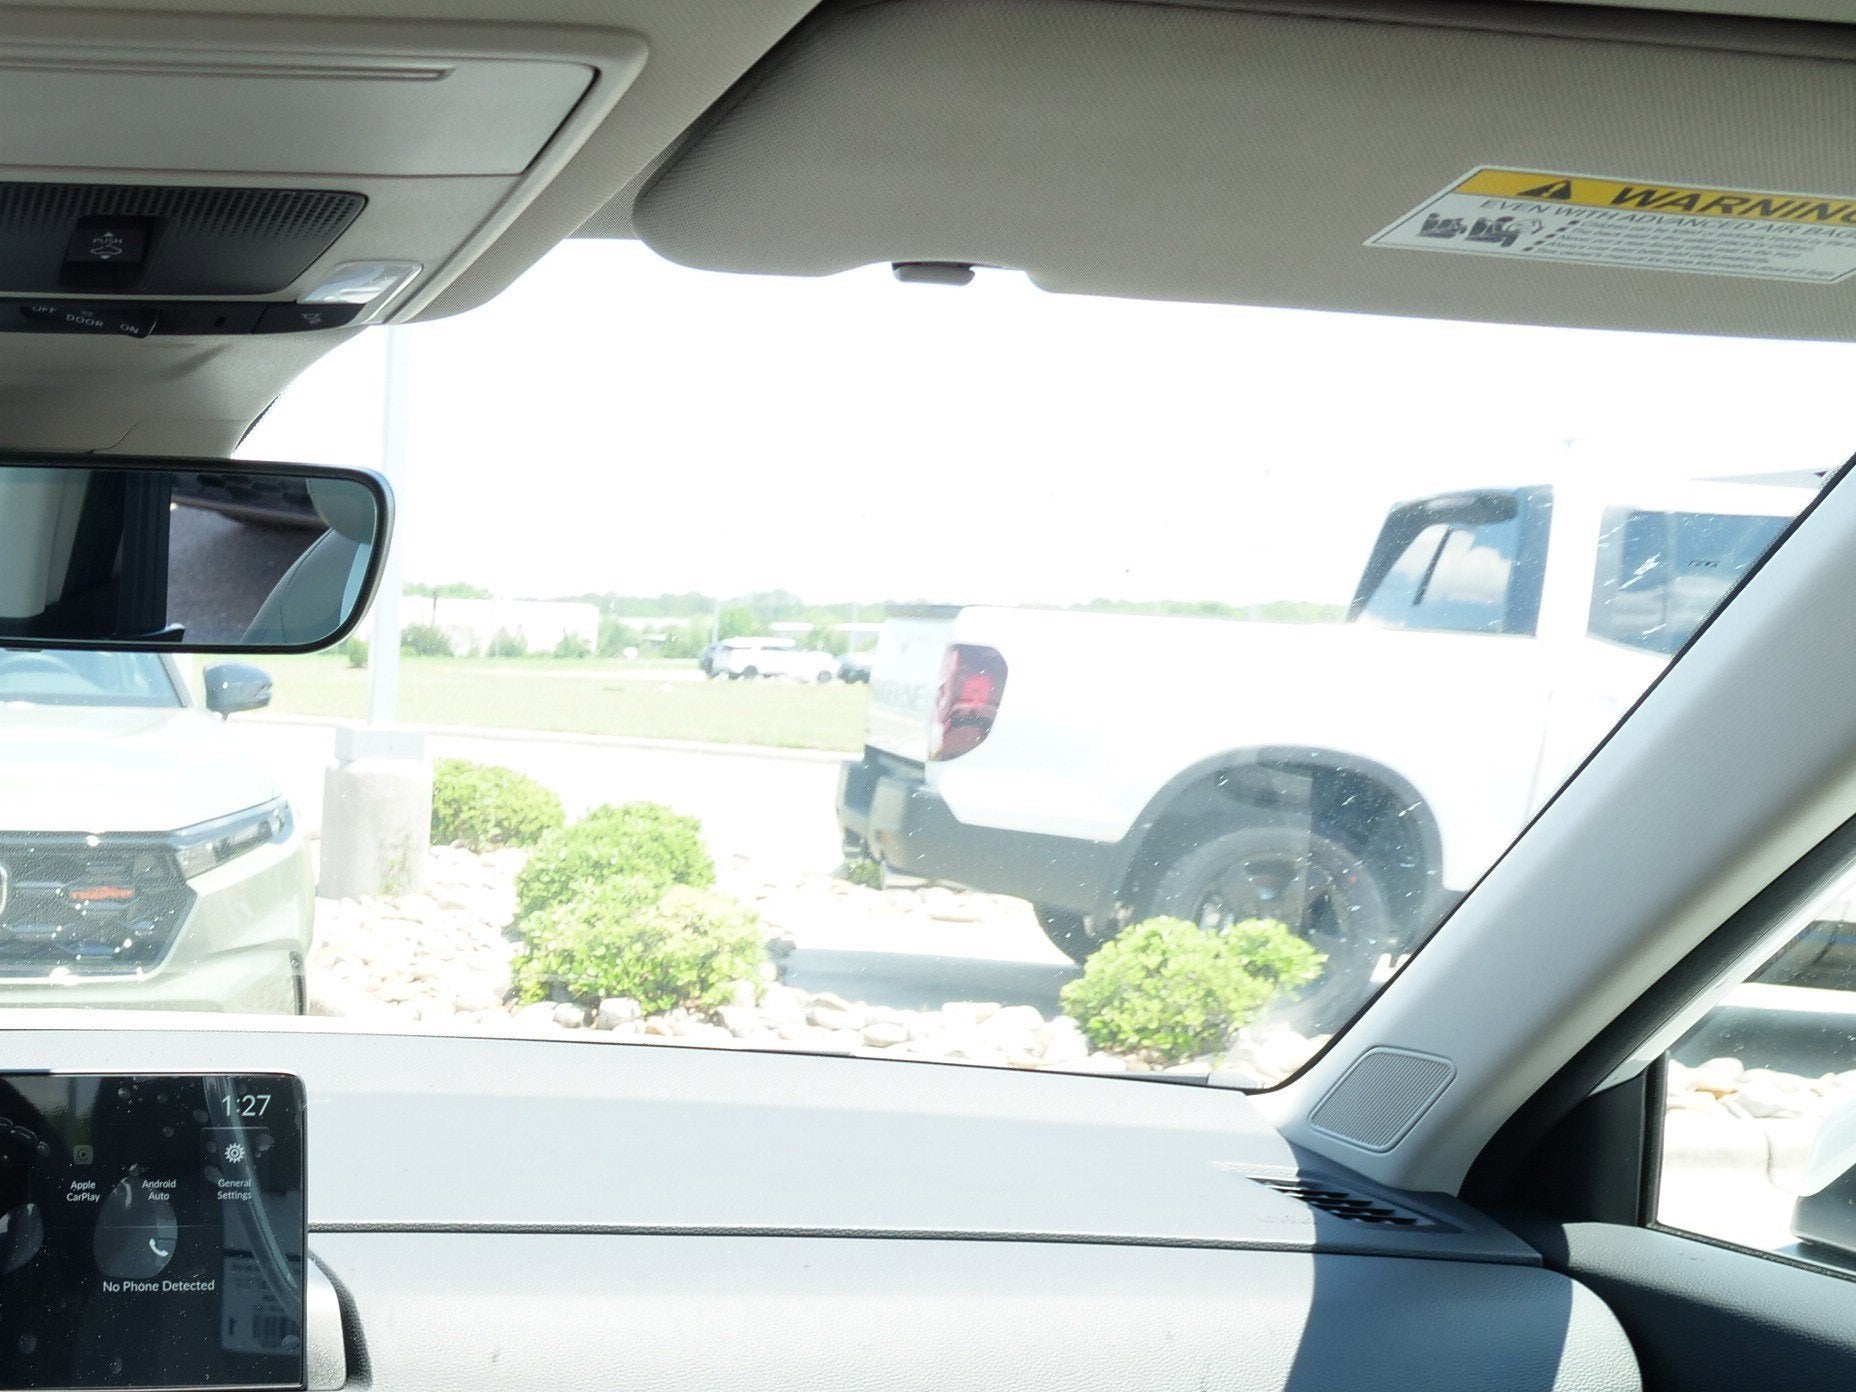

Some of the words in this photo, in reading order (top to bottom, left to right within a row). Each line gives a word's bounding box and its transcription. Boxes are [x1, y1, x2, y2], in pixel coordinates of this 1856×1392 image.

[1480, 199, 1546, 214] EVEN
[1554, 207, 1614, 221] WITH
[1616, 213, 1756, 232] ADVANCED
[1763, 223, 1804, 235] AIR
[66, 314, 104, 328] DOOR
[120, 323, 139, 334] ON
[222, 1094, 271, 1117] 1:27
[70, 1181, 96, 1191] Apple
[142, 1179, 176, 1189] Android
[217, 1179, 252, 1188] General
[66, 1192, 100, 1203] CarPlay
[148, 1192, 170, 1201] Auto
[217, 1191, 252, 1201] Settings
[102, 1281, 120, 1292] No
[123, 1280, 159, 1292] Phone
[162, 1280, 215, 1291] Detected
